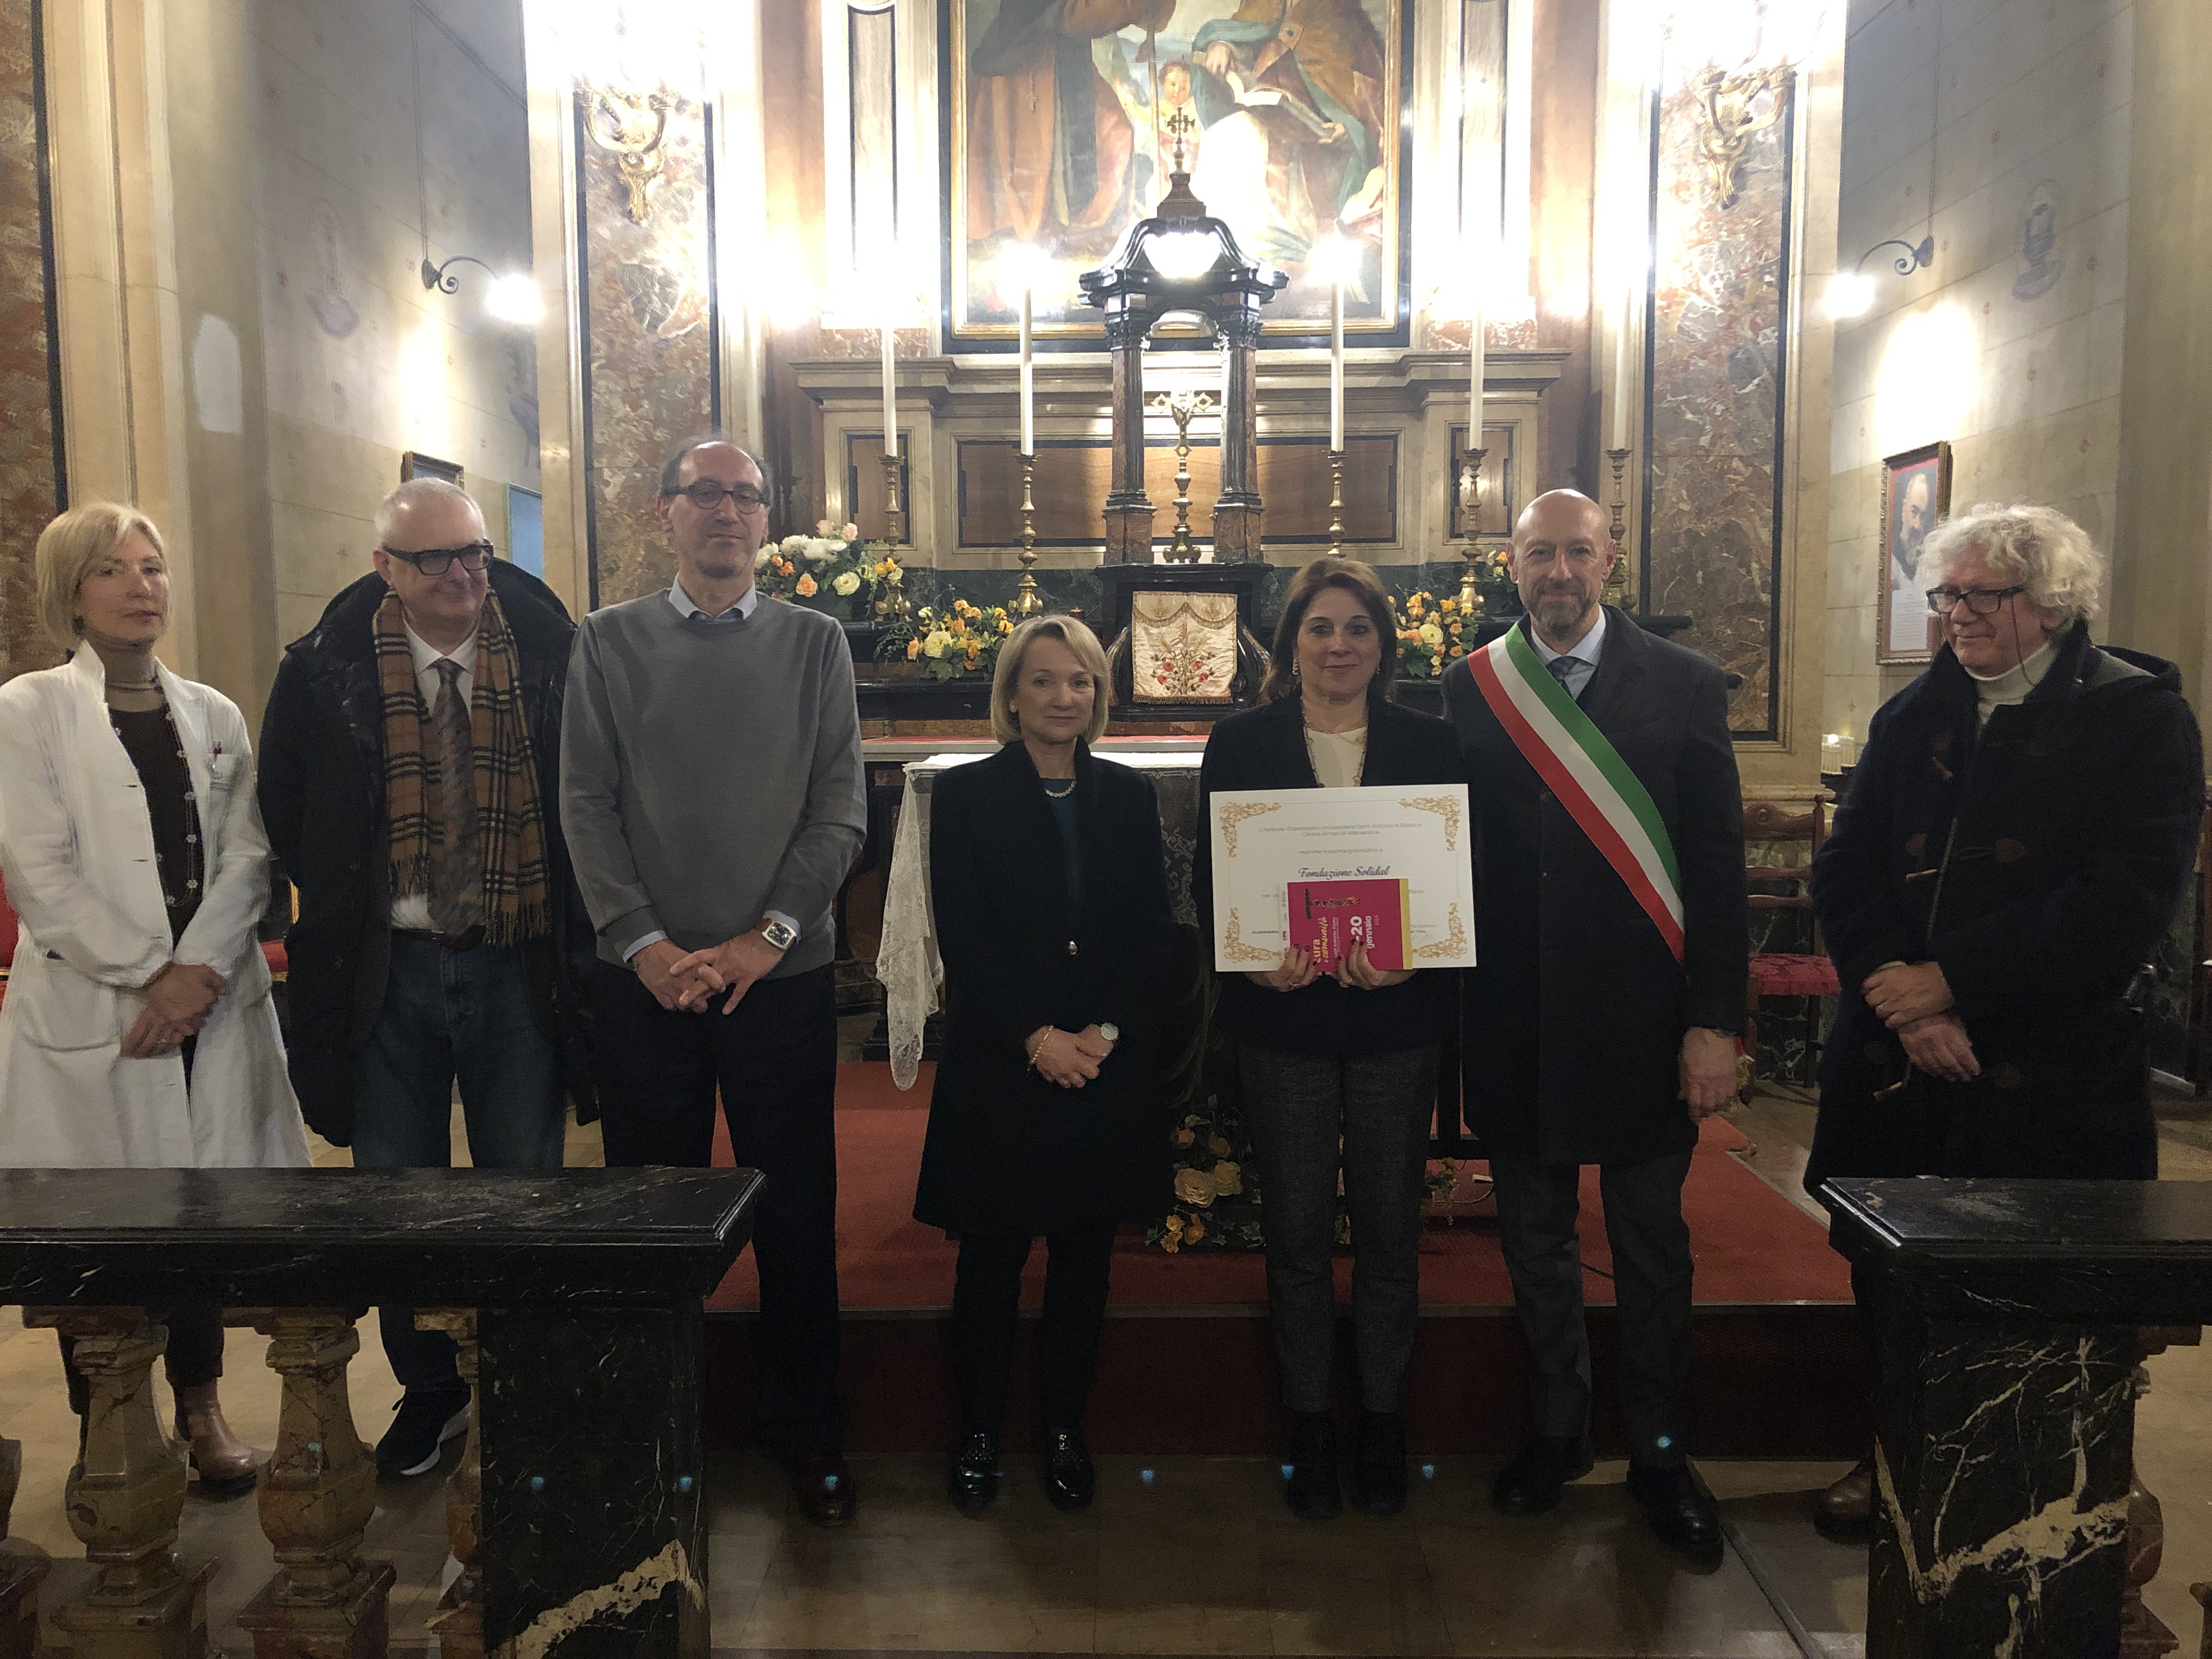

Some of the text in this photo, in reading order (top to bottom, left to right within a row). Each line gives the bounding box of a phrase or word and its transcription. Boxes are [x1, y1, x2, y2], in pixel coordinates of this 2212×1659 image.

[1298, 865, 1390, 880] Fondazione Solidal
[1363, 915, 1375, 949] gennaio
